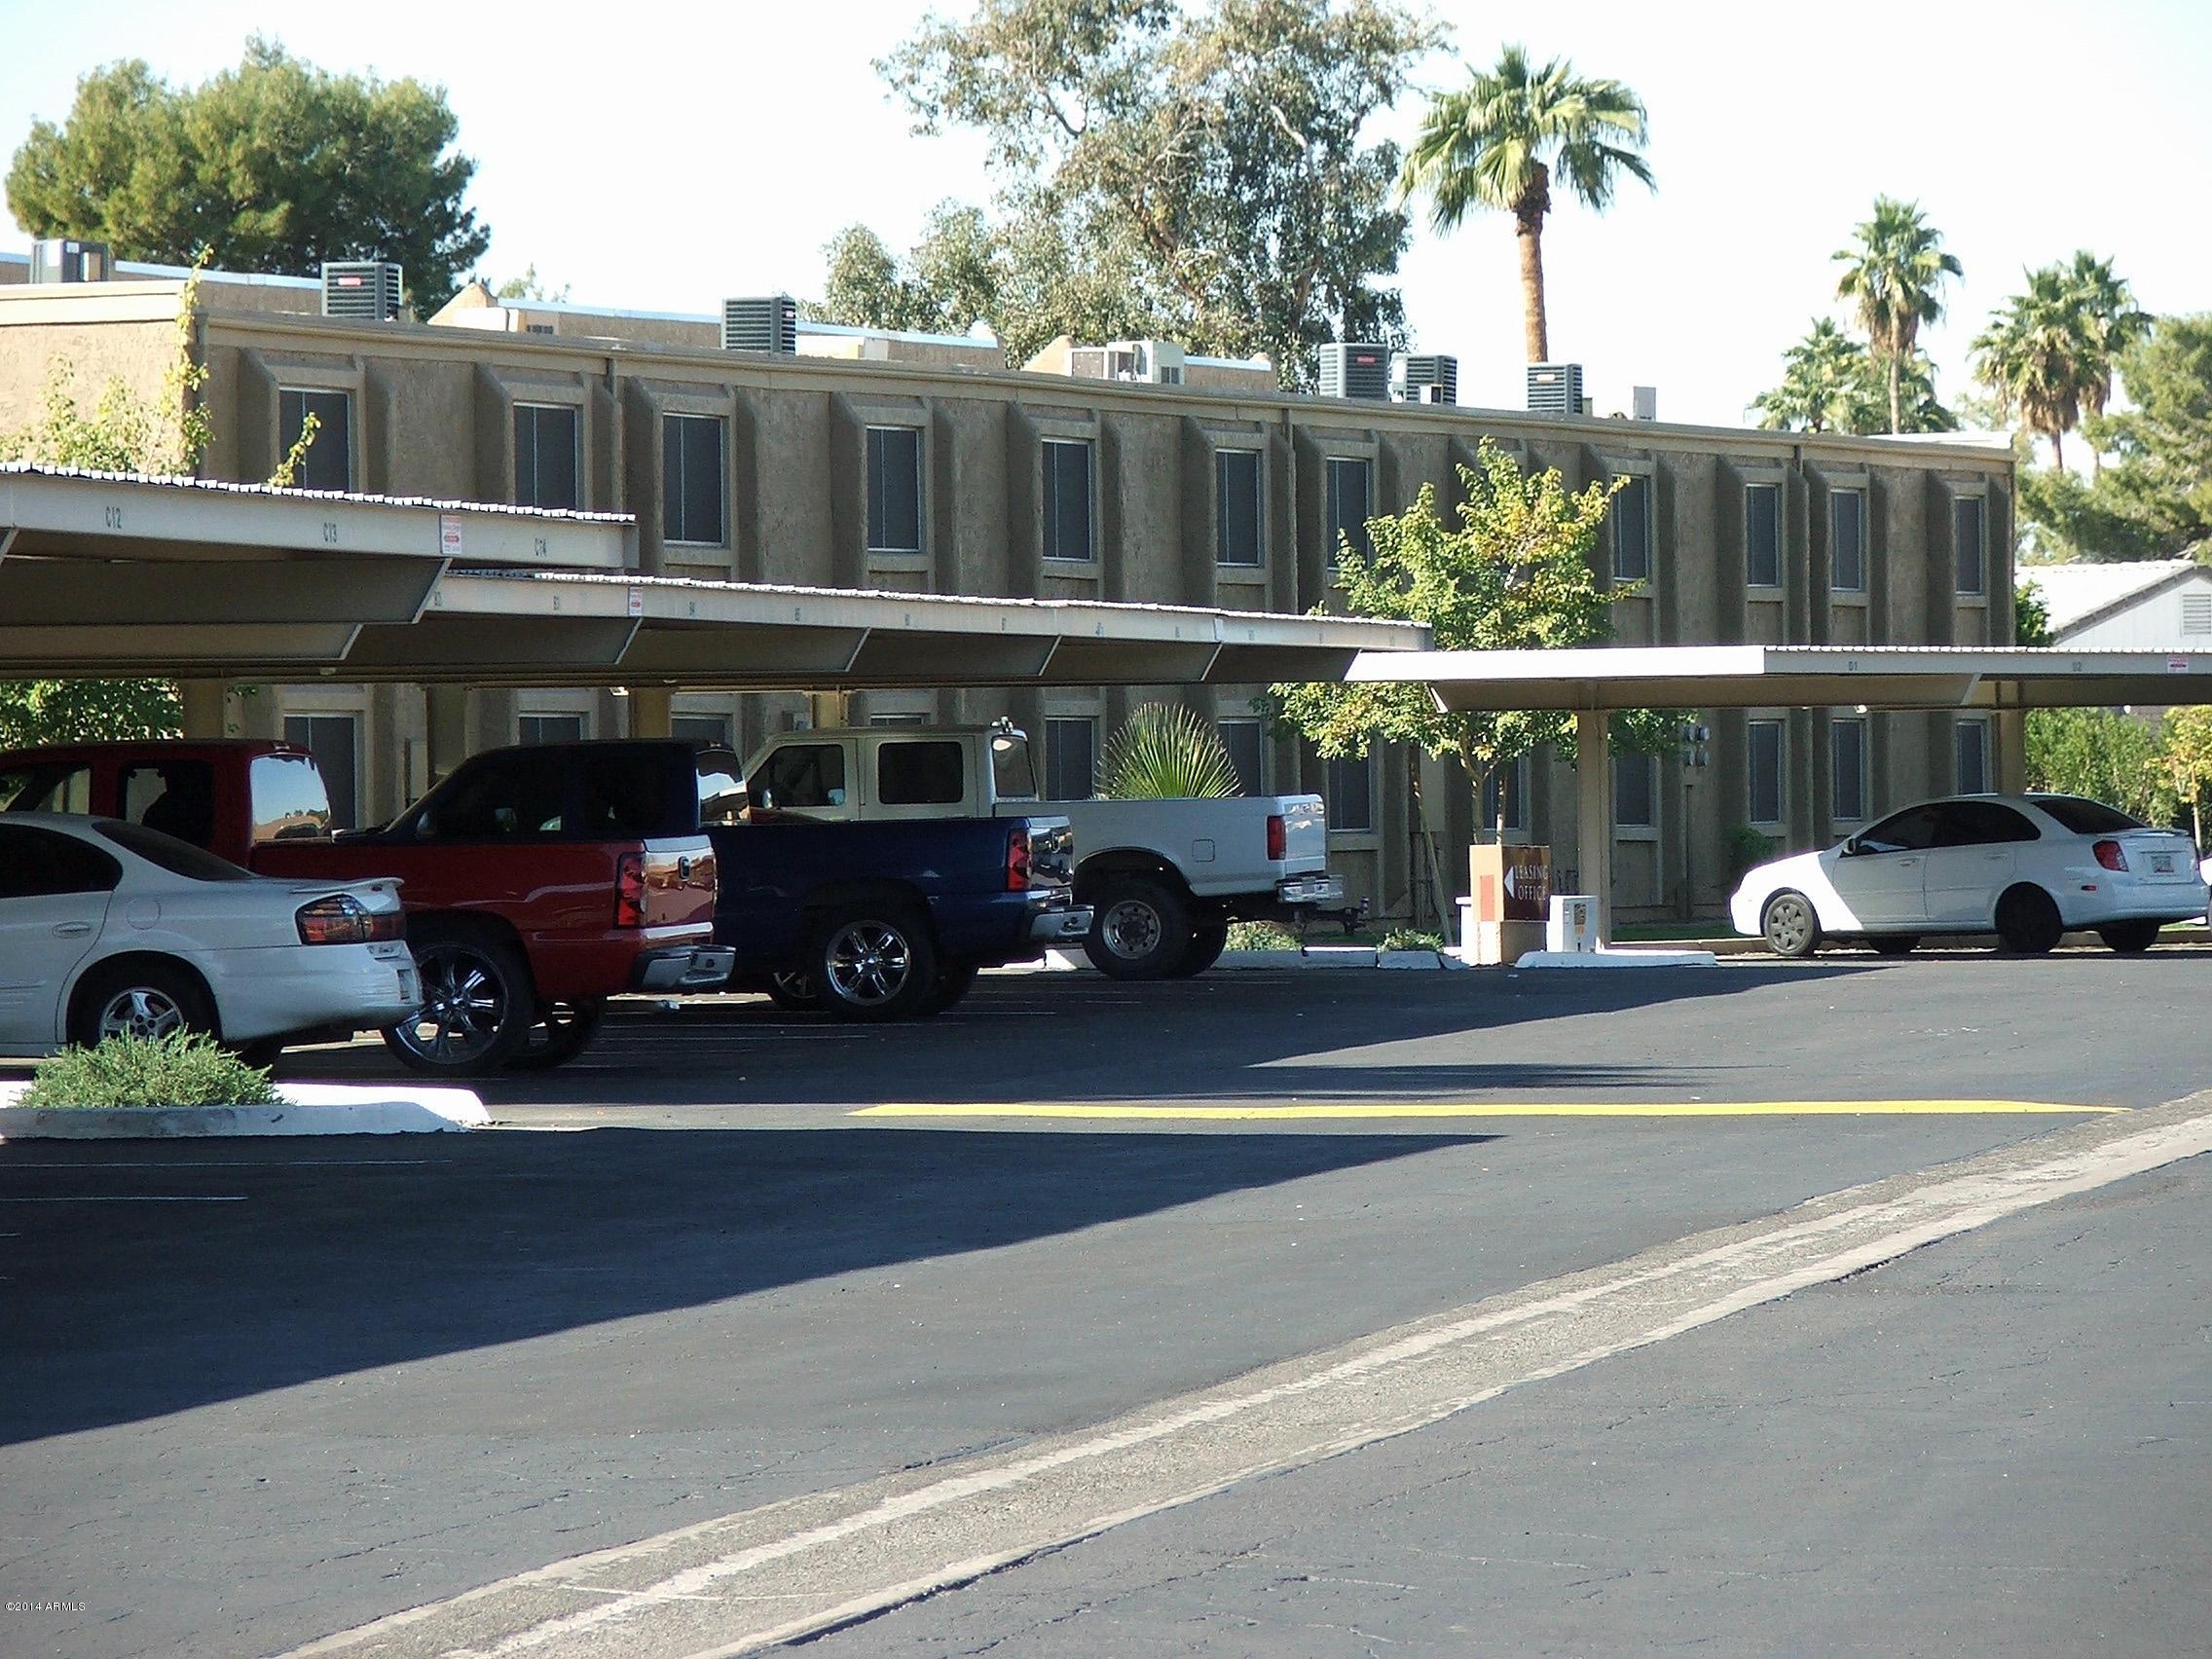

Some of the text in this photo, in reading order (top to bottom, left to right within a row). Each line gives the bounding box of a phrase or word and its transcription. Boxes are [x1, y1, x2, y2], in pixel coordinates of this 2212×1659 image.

[105, 505, 122, 529] C12
[322, 522, 337, 543] C13
[1514, 865, 1548, 880] LEASING
[1518, 885, 1546, 901] OFFICE
